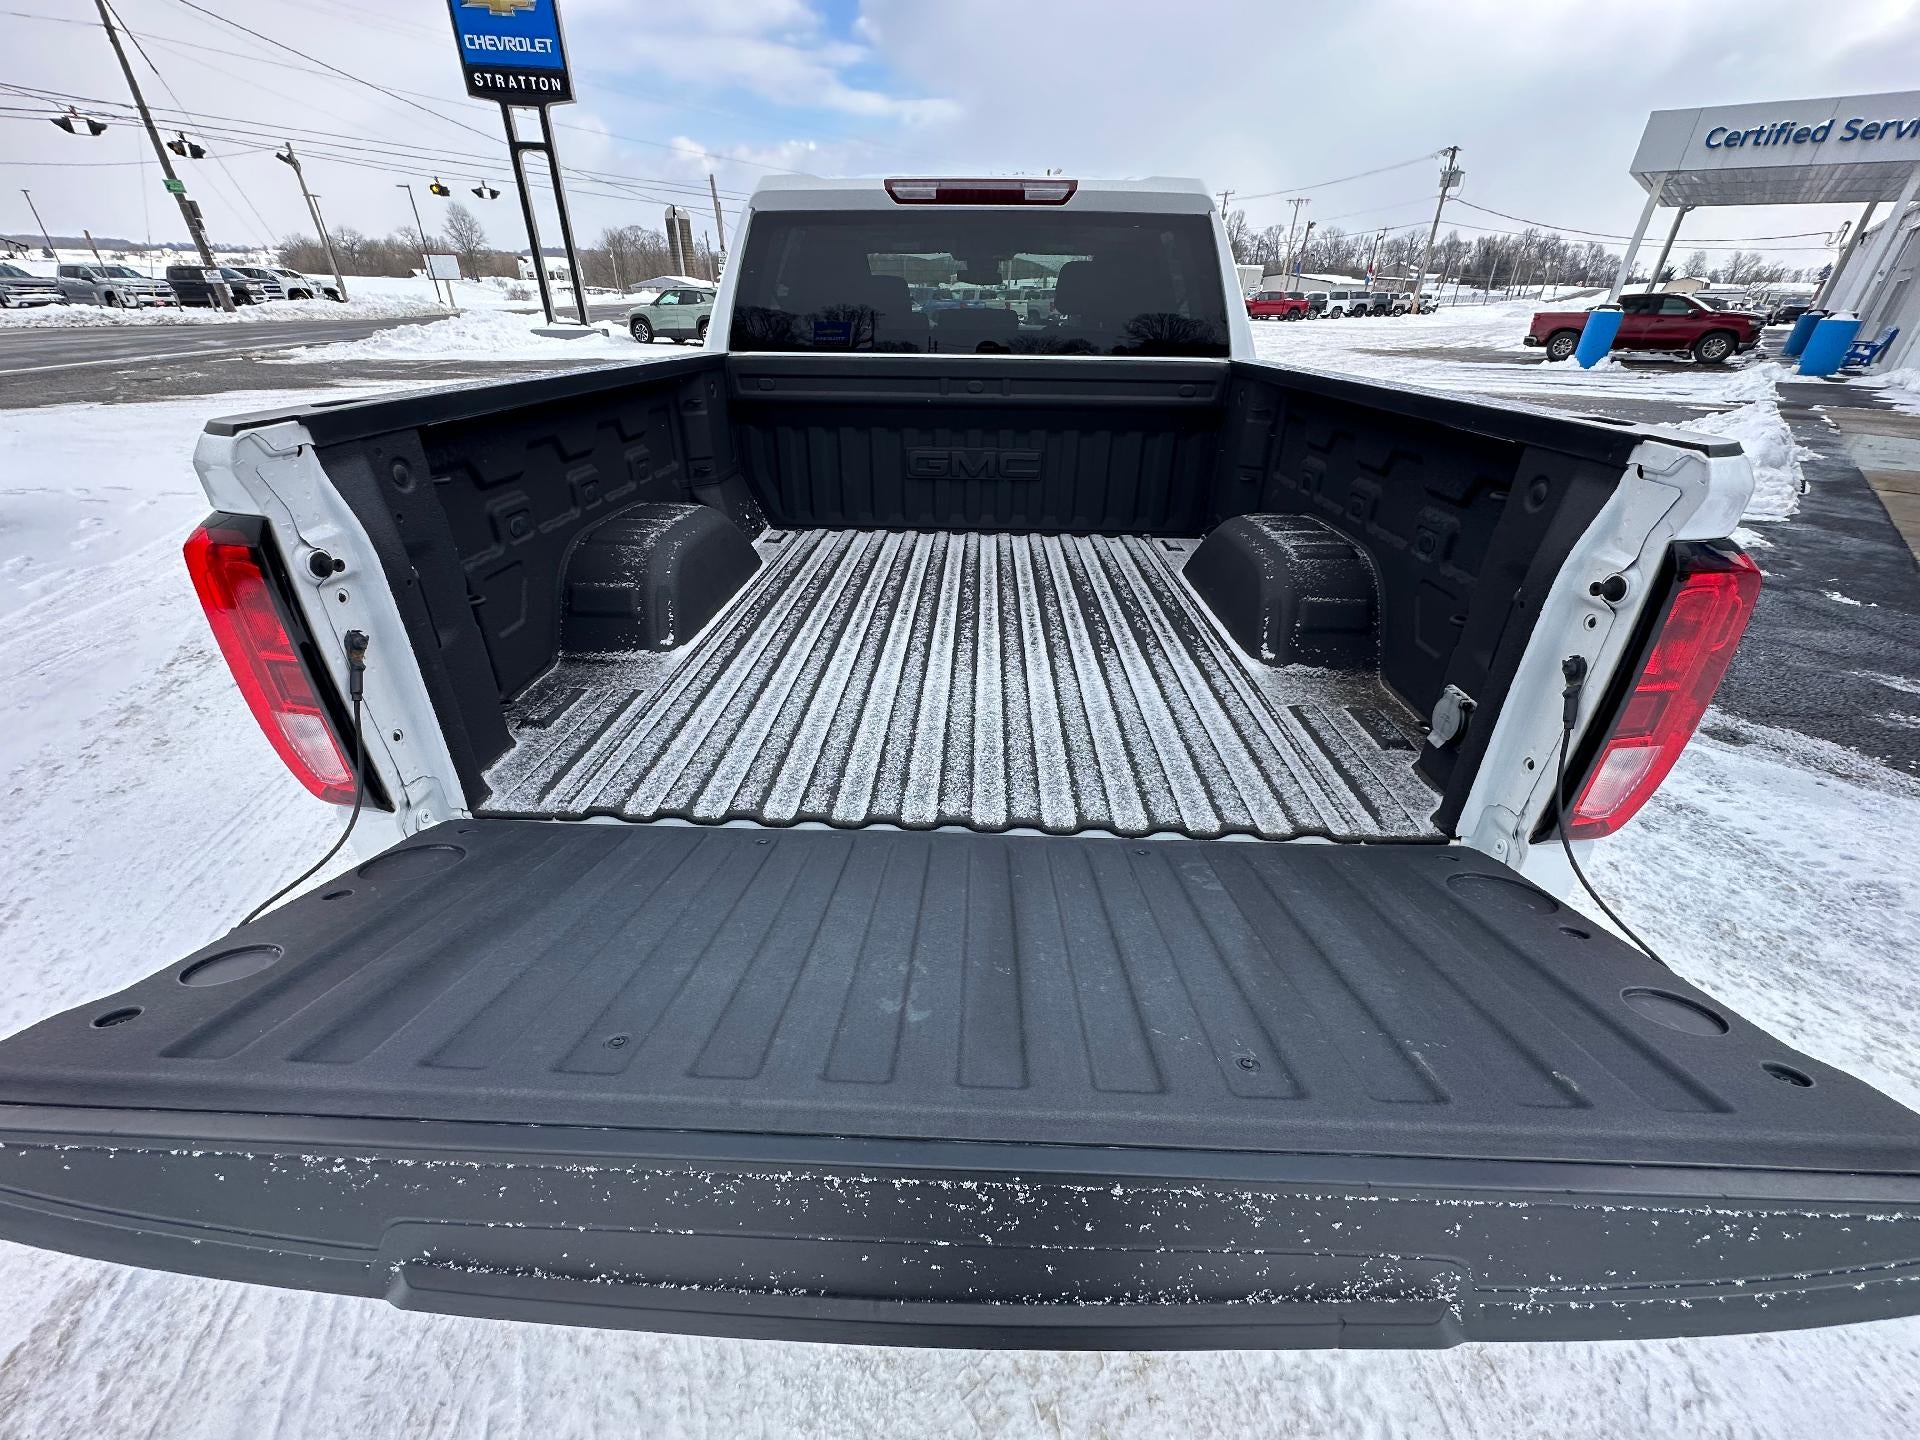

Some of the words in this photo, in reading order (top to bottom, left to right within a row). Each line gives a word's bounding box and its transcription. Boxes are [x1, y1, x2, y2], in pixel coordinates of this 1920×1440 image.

[463, 34, 553, 53] CHEVROLET
[473, 72, 561, 91] STRATTON
[1705, 118, 1836, 149] Certified
[908, 450, 1041, 479] GMC
